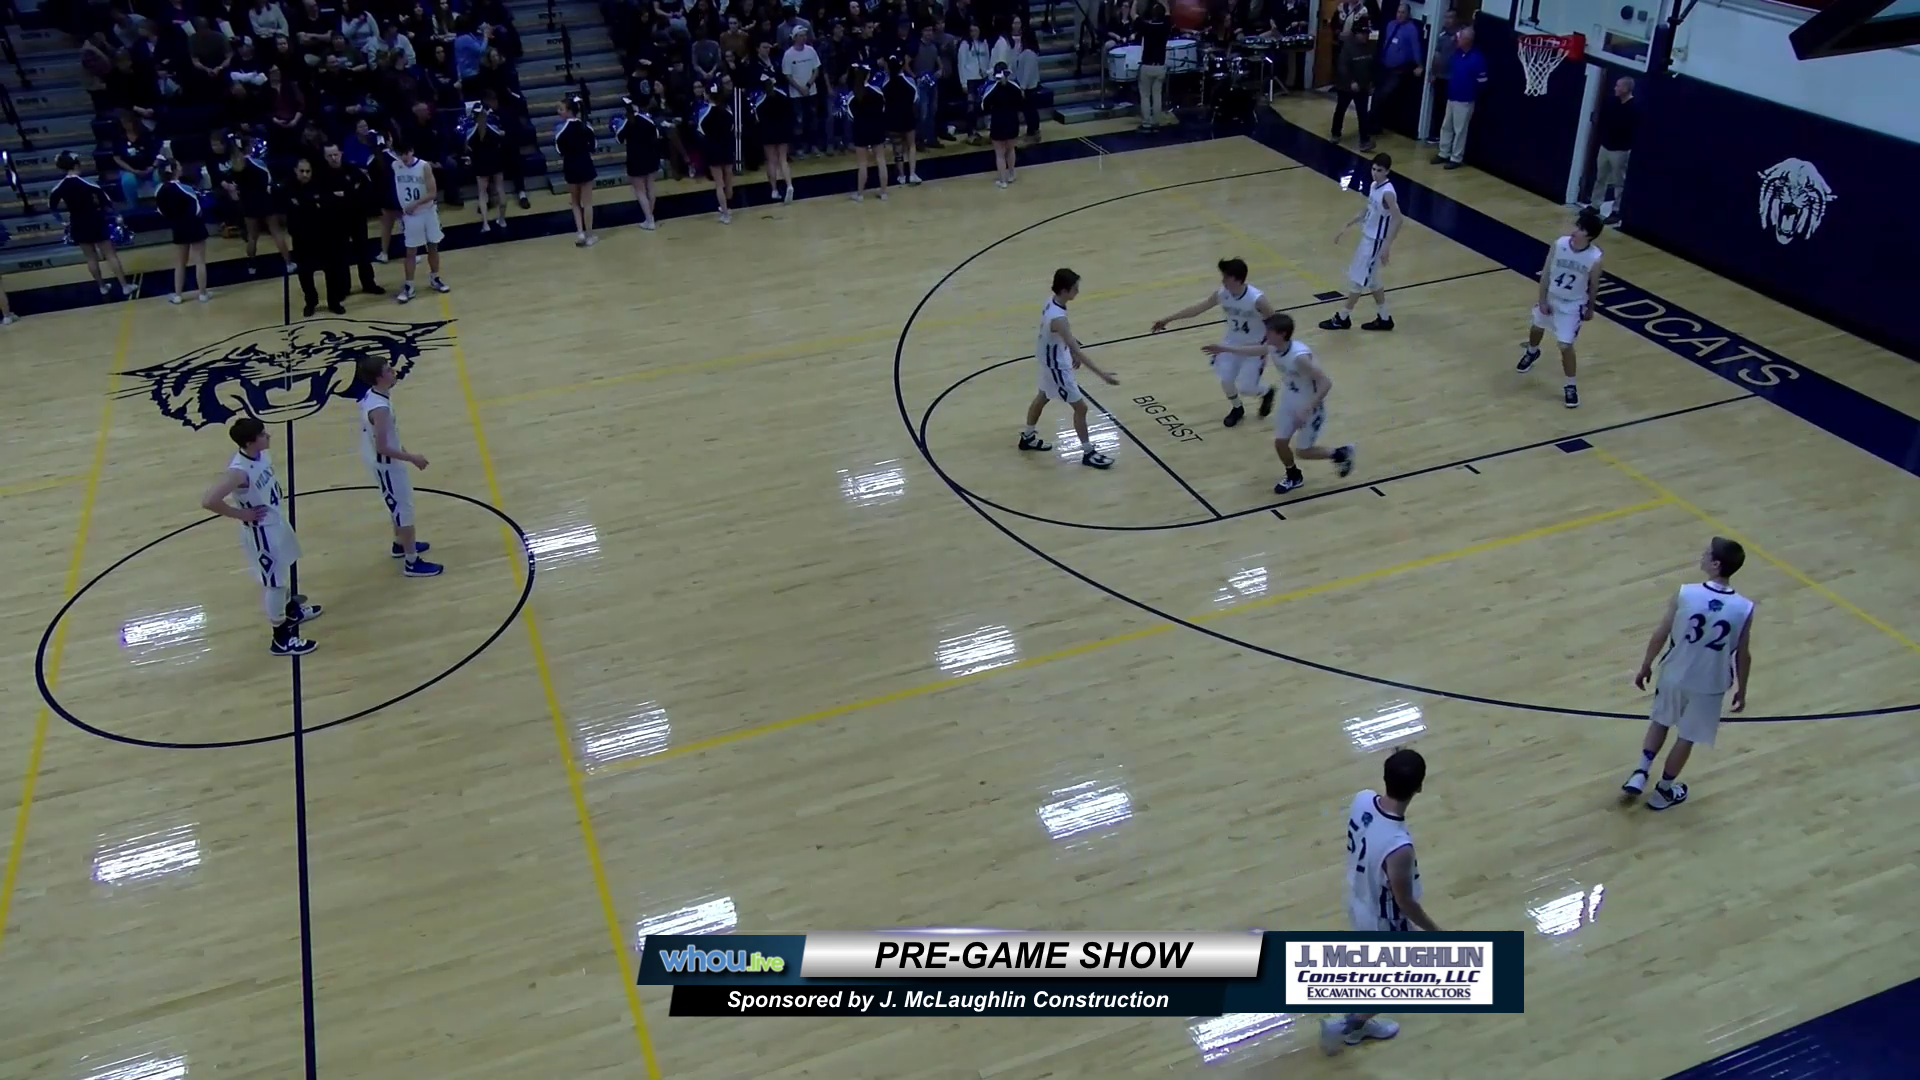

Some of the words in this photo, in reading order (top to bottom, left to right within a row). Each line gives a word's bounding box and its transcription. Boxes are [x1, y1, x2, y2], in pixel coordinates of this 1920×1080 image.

[595, 179, 615, 187] ROW
[404, 187, 420, 202] 30
[16, 225, 41, 233] ROW
[18, 260, 43, 269] ROW
[1554, 272, 1577, 290] 42
[1536, 270, 1800, 387] ILDCATS
[1133, 395, 1167, 415] BIG
[1155, 414, 1204, 442] EAST
[1685, 613, 1731, 652] 32
